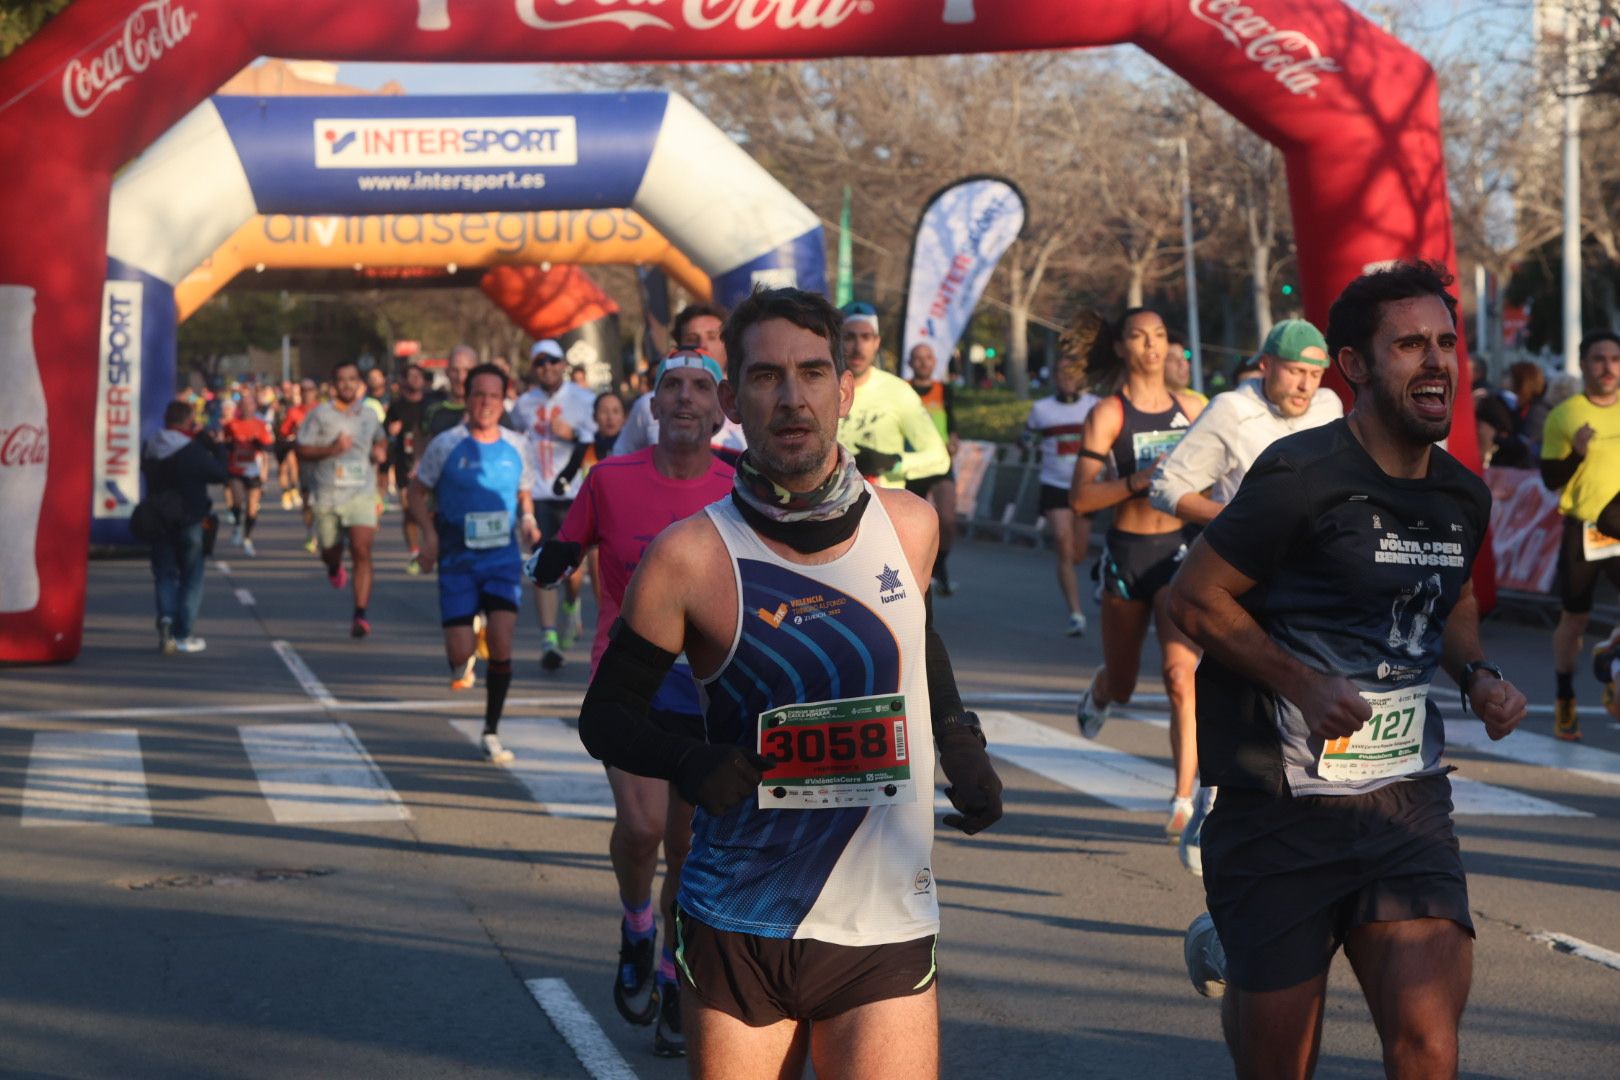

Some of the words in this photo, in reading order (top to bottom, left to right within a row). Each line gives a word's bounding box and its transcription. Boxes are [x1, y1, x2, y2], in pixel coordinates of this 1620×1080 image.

[62, 0, 194, 118] Coca-Cola
[363, 127, 560, 155] INTERSPORT
[357, 170, 546, 193] www.intersport.es
[105, 294, 131, 476] INTERSPORT
[1379, 538, 1420, 553] VOLTA
[1432, 542, 1462, 554] PEU
[790, 594, 824, 608] VALENCIA
[881, 590, 907, 604] luanvi
[767, 723, 888, 763] 3058
